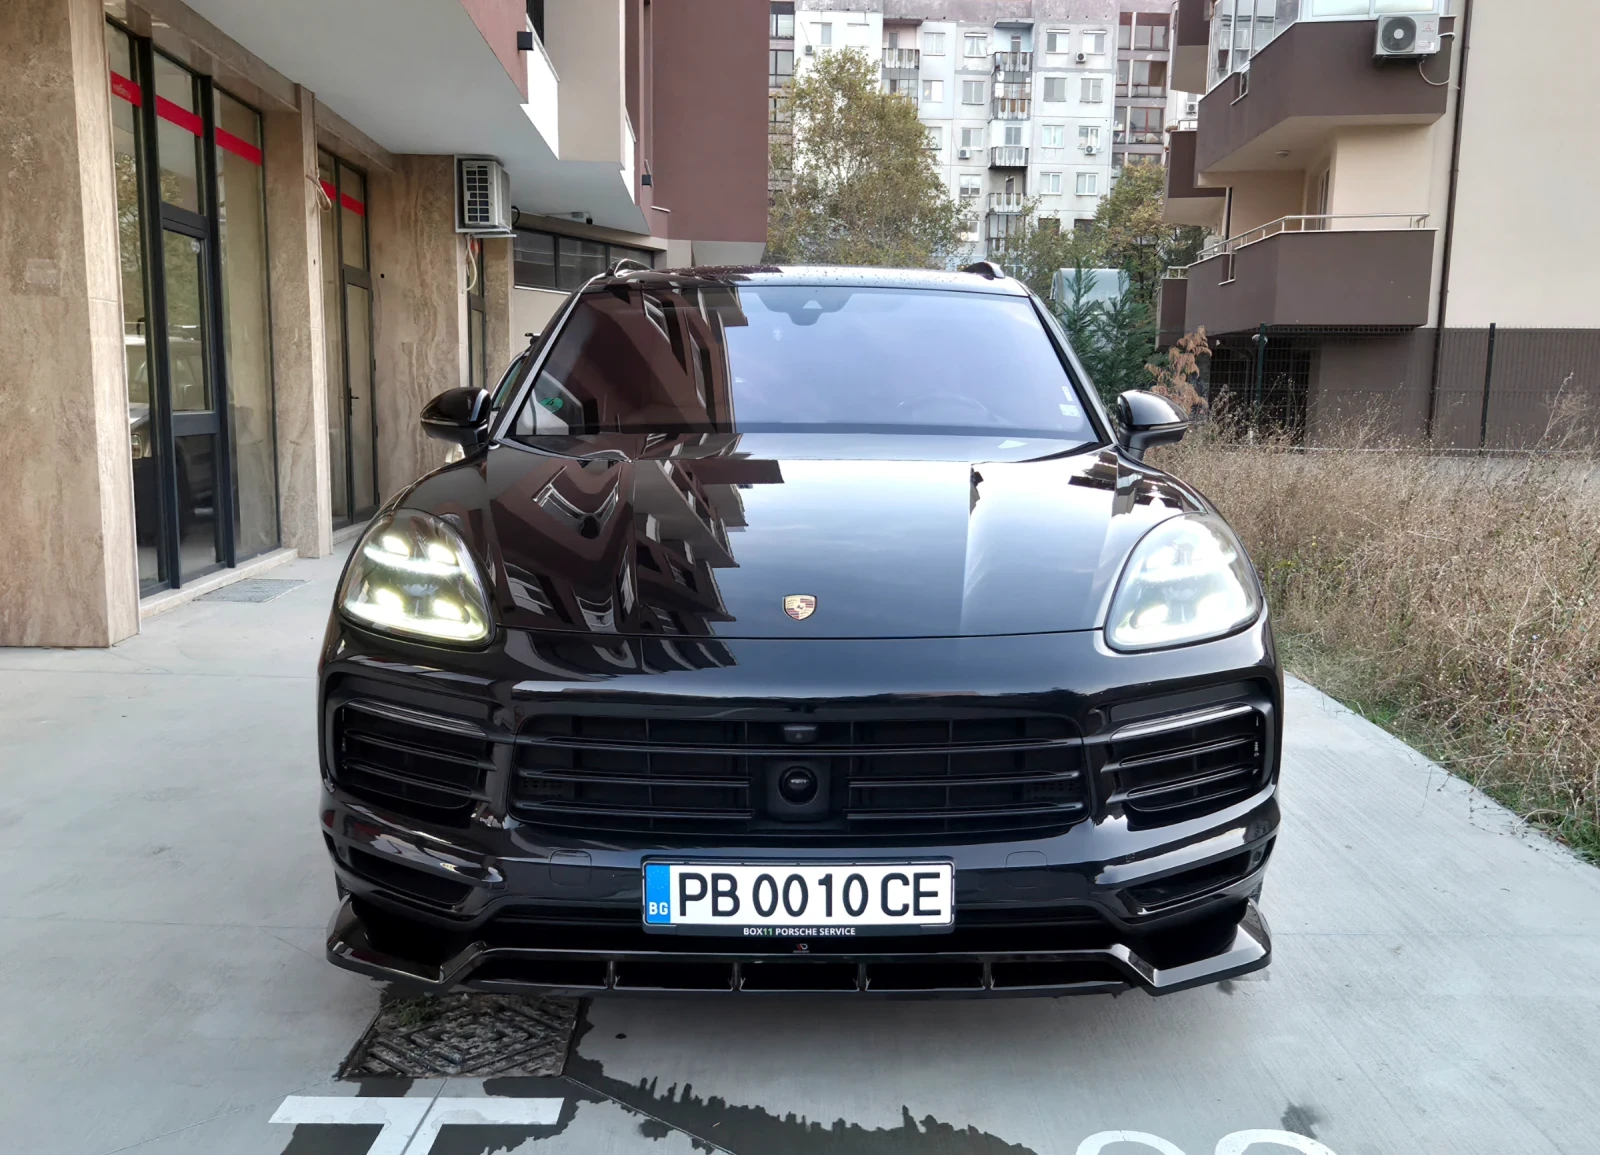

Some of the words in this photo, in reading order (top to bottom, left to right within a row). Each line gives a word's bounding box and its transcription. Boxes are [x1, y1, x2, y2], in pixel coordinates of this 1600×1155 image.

[679, 872, 741, 917] PB
[752, 873, 869, 918] 0010
[880, 872, 942, 917] CE
[648, 902, 669, 915] BG
[743, 927, 773, 936] BOX11
[775, 927, 818, 936] PORSCHE
[819, 927, 856, 936] SERVICE
